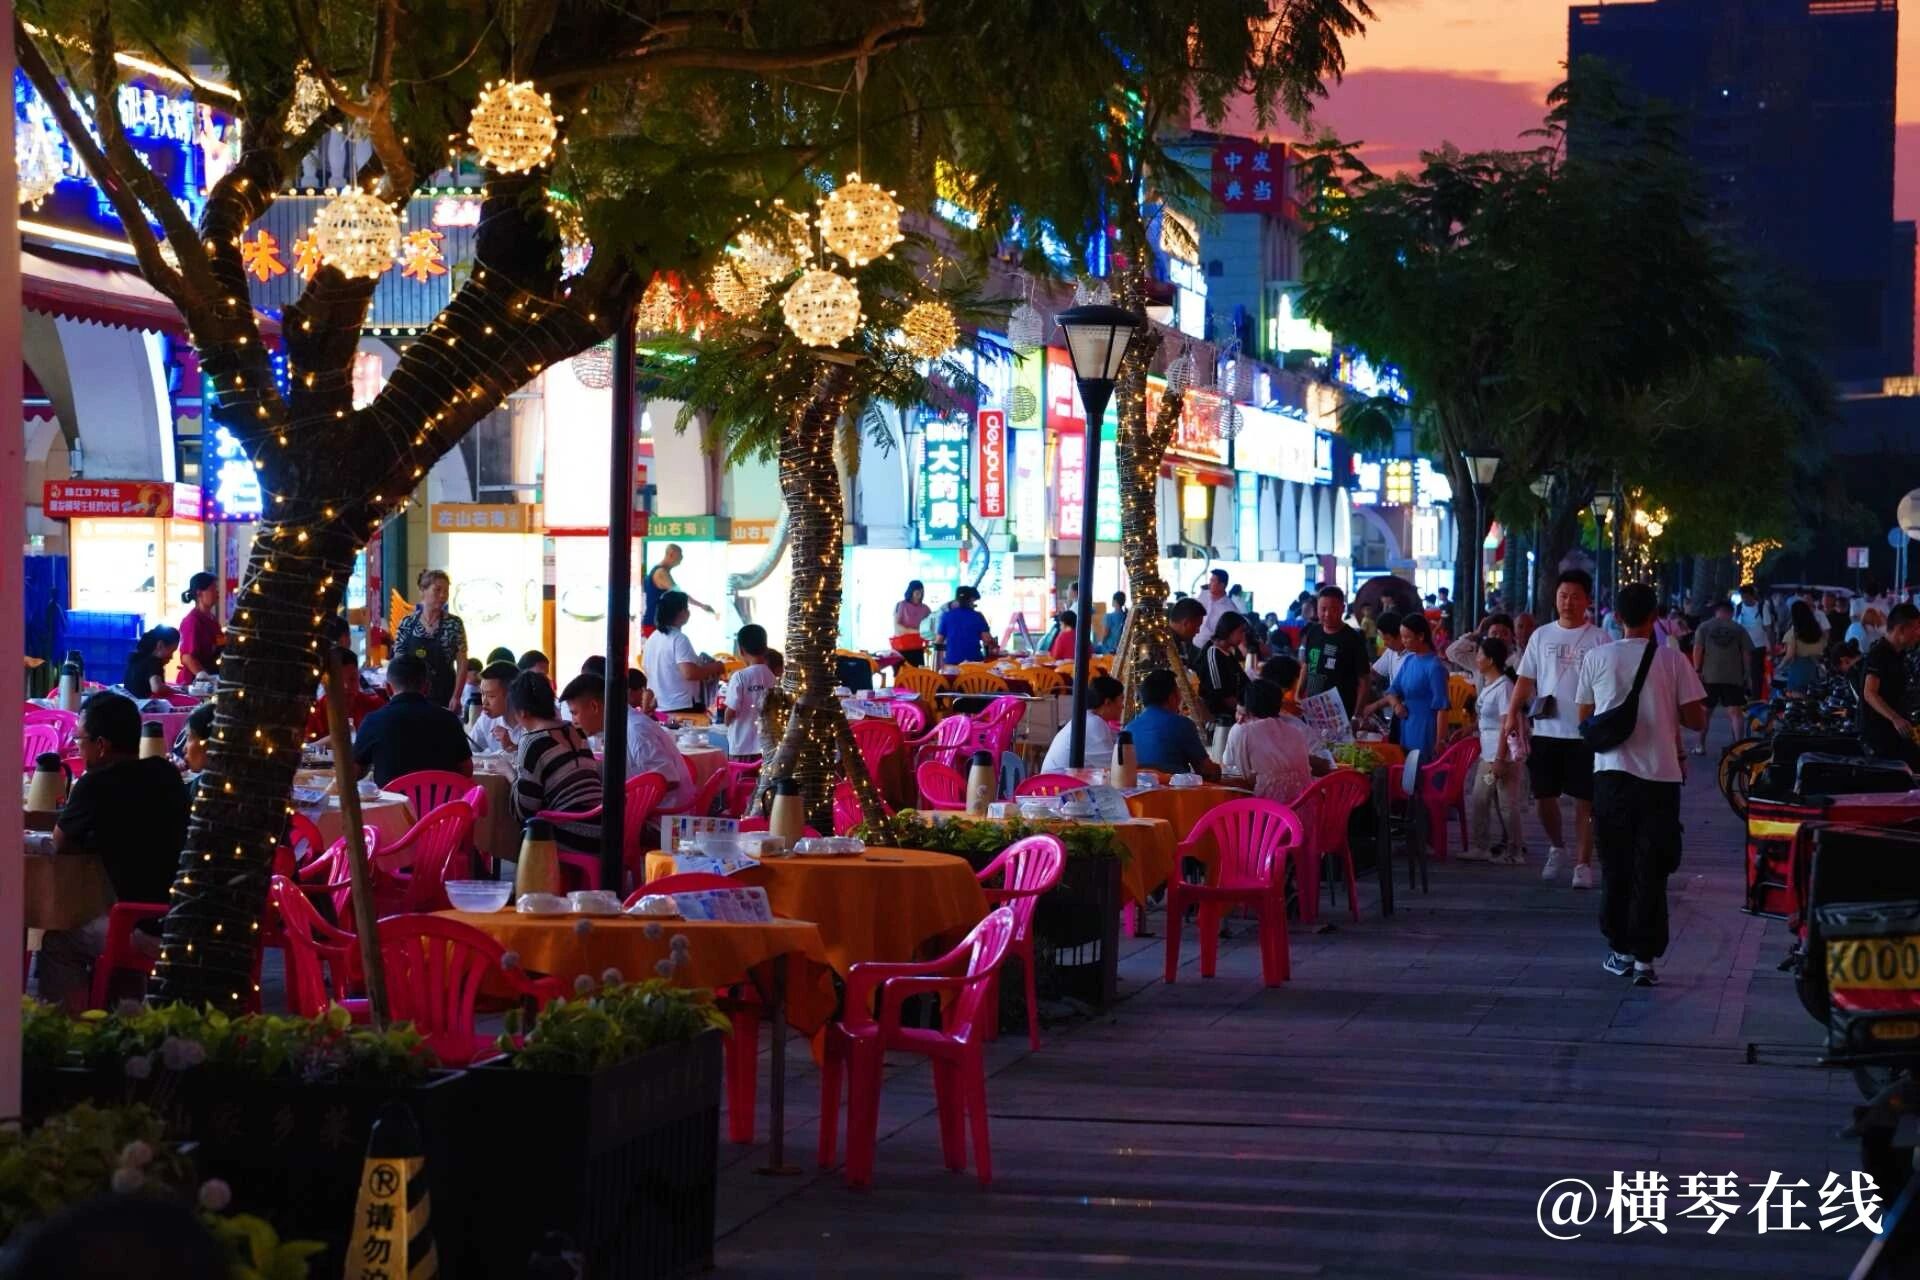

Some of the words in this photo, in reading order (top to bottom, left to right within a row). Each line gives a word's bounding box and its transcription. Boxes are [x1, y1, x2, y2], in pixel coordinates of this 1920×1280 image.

[927, 443, 961, 530] 大药房
[982, 415, 1001, 481] deyou
[1058, 434, 1084, 536] 便利店
